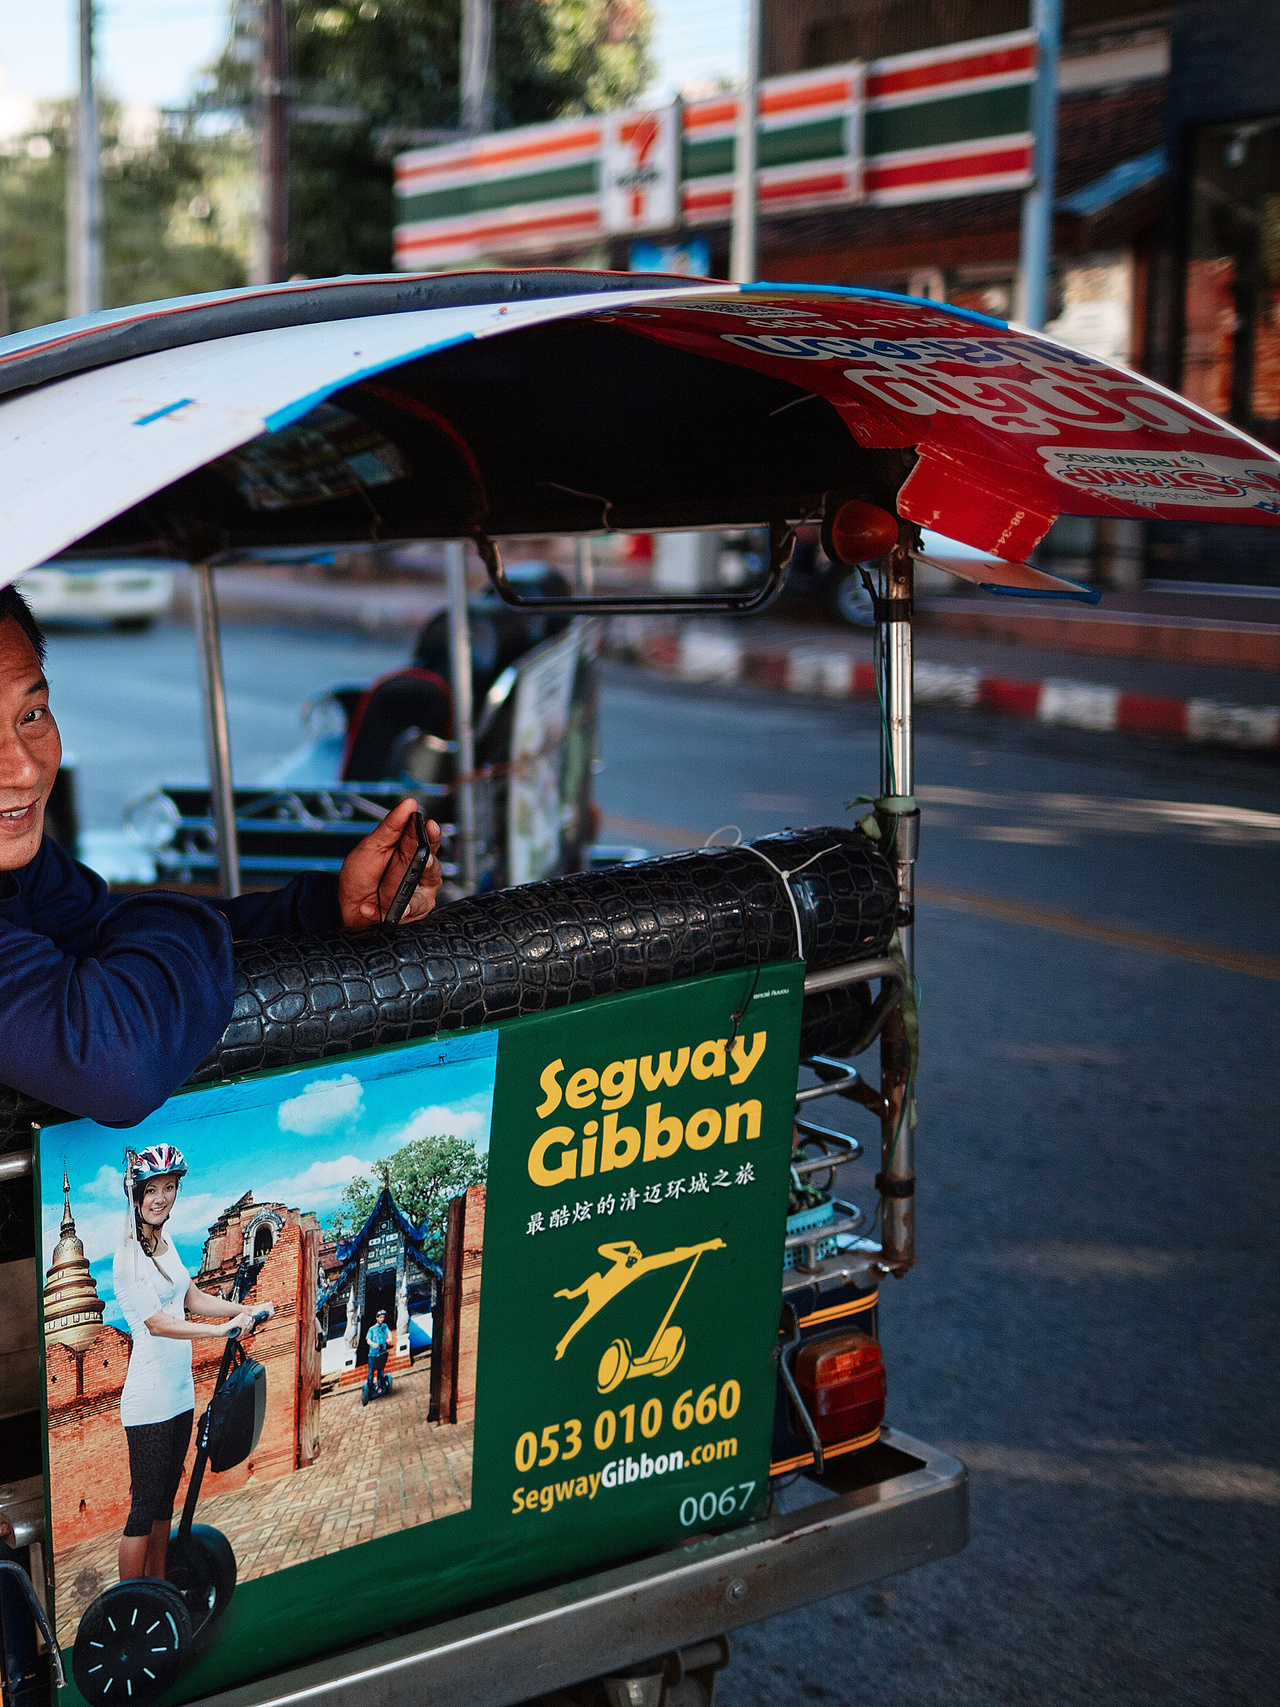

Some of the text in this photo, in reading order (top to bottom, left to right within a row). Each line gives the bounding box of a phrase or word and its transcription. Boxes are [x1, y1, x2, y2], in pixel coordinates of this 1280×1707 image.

[535, 1030, 767, 1119] Segway
[527, 1098, 762, 1187] Gibbon
[525, 1161, 756, 1236] 最酷炫的清迈环城之旅
[514, 1379, 741, 1472] 053 010 660
[511, 1437, 738, 1514] SegwayGibbon.com
[679, 1481, 756, 1526] 0067
